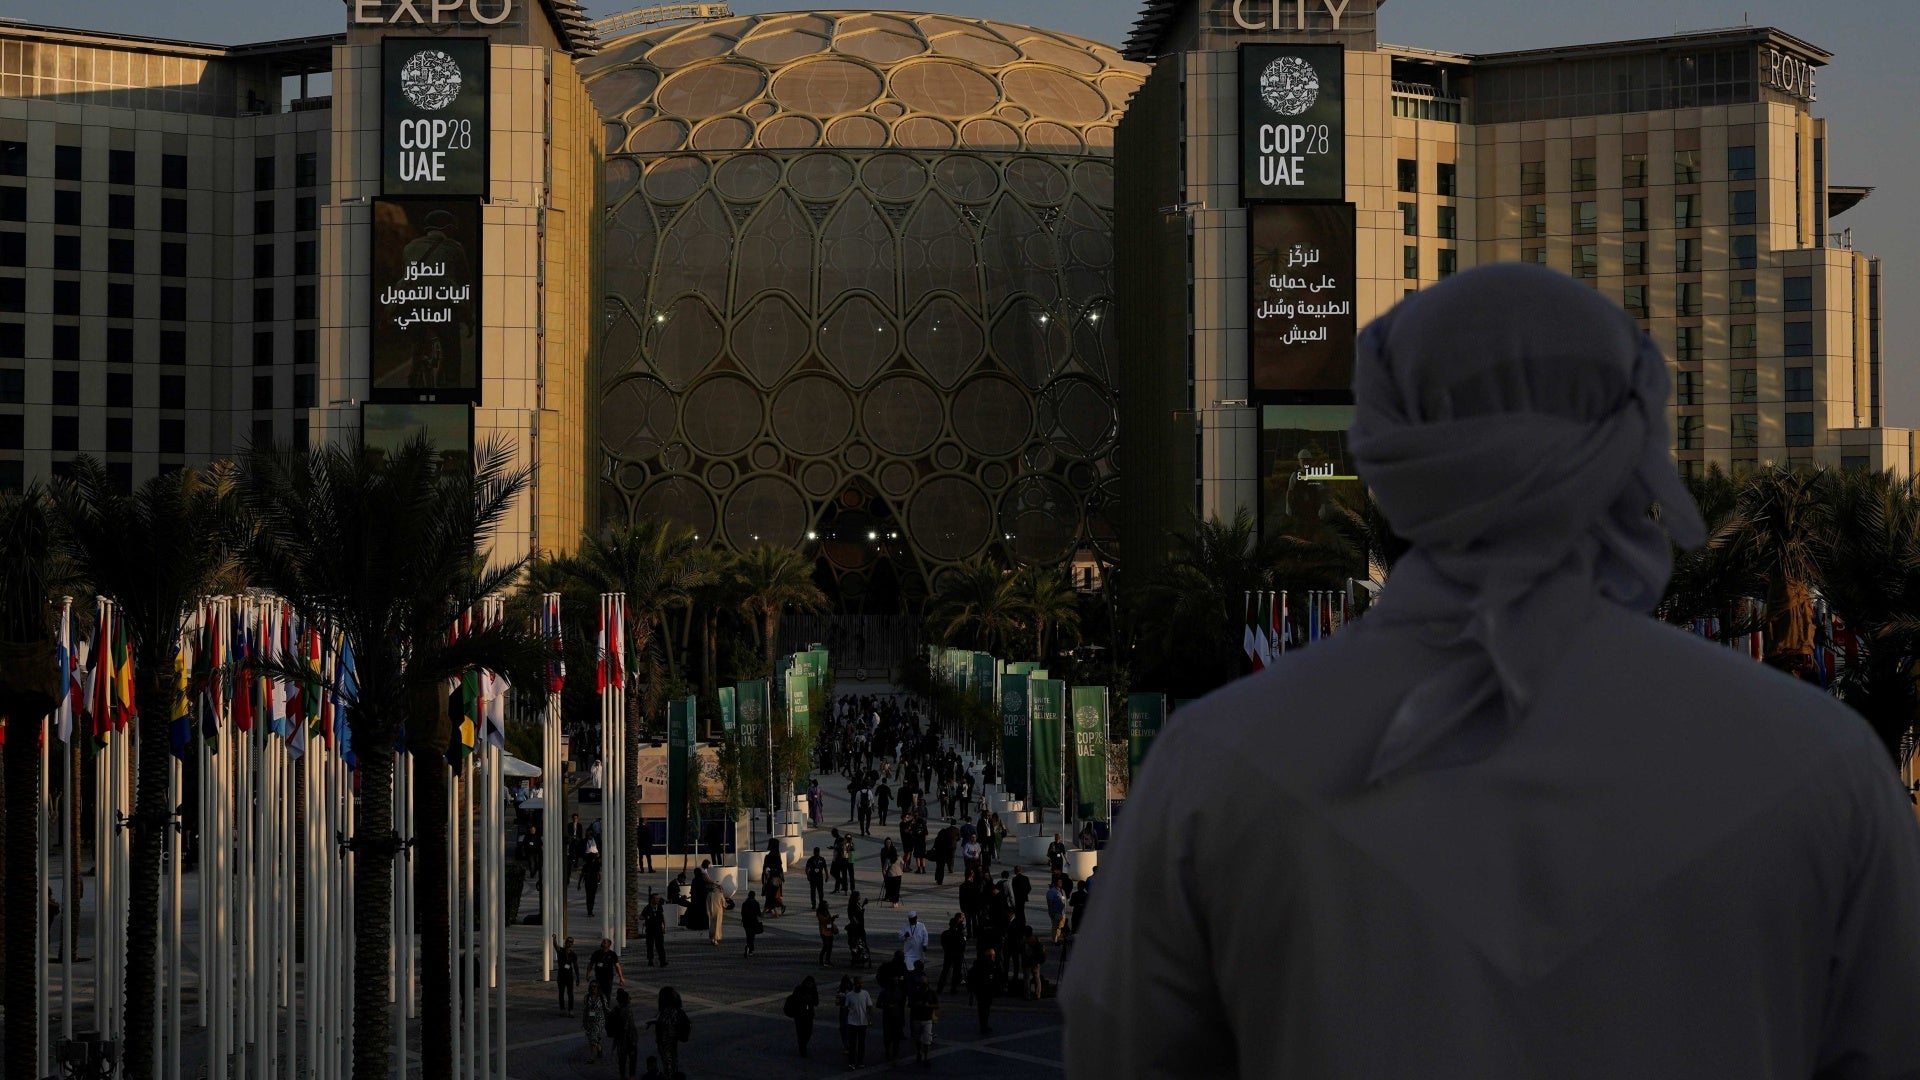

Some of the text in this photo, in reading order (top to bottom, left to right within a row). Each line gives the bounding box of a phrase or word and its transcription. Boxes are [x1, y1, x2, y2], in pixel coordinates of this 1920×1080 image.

[355, 0, 512, 24] EXPO
[1769, 48, 1817, 102] ROVE
[399, 119, 471, 150] COP28
[1259, 124, 1329, 154] COP28
[399, 151, 446, 182] UAE
[1259, 156, 1305, 186] UAE
[1269, 274, 1336, 293] على حماية
[380, 284, 470, 304] آليات التمويل
[1297, 300, 1350, 318] الطبيعة
[1003, 714, 1026, 725] COP28
[1004, 725, 1018, 736] UAE
[741, 735, 758, 747] UAE
[1077, 744, 1096, 756] UAE
